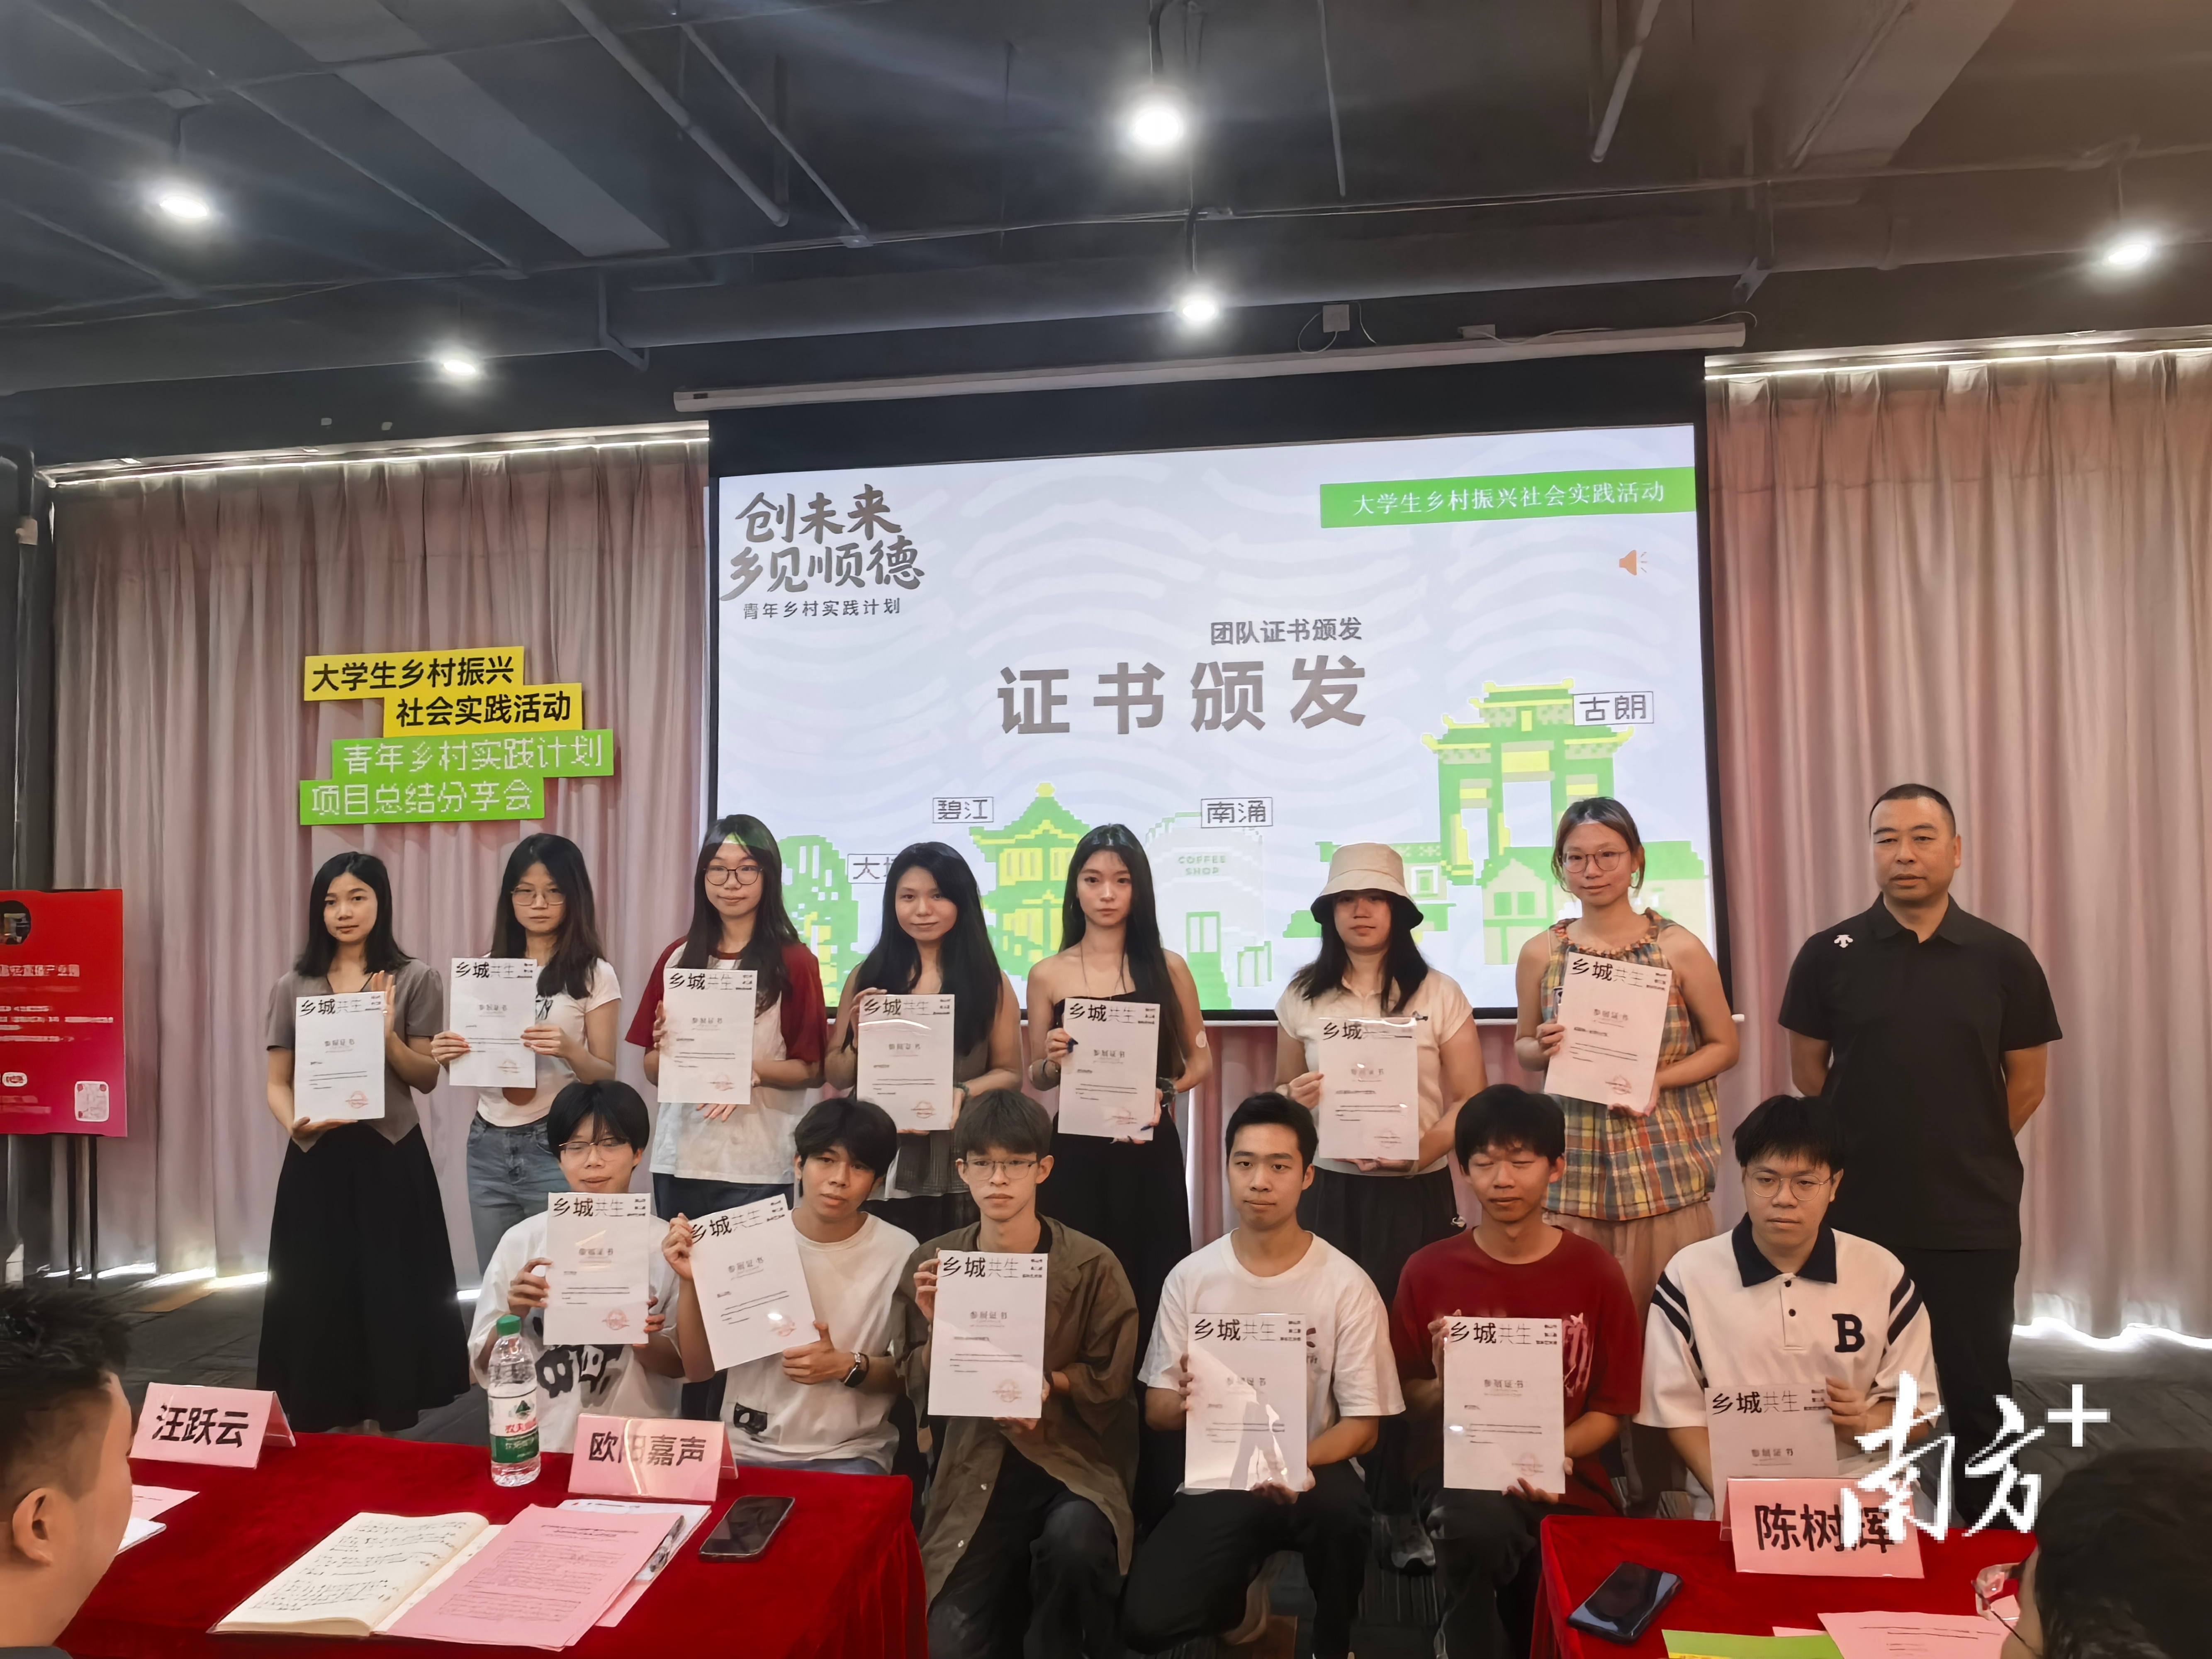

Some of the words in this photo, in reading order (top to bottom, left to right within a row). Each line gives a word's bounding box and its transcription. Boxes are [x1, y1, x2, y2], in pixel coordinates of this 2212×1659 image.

[1353, 481, 1664, 516] 大学生乡村振兴社会实践活动
[735, 484, 903, 544] 创未来
[720, 535, 925, 601] 乡见顺德
[743, 598, 900, 620] 青年乡村实践计划
[1210, 617, 1363, 645] 团队证书颁发
[311, 656, 514, 692] 大学生乡村振兴
[998, 655, 1366, 735] 证书颁发
[1578, 694, 1647, 722] 古朗
[396, 691, 571, 727] 社会实践活动
[343, 735, 602, 774] 青年乡村实践计划
[311, 778, 532, 816] 项目总结分享会
[937, 799, 989, 820] 碧江
[1207, 800, 1266, 824] 南涌
[1185, 867, 1219, 876] SHOP
[455, 961, 514, 978] 乡城共生
[669, 973, 733, 990] 乡城共生
[1569, 958, 1644, 987] 乡城共生
[299, 999, 364, 1017] 乡城共生
[864, 998, 930, 1016] 乡城共生
[1067, 1003, 1136, 1024] 乡城共生
[552, 1197, 623, 1217] 乡城共生
[691, 1209, 763, 1243] 乡城共生
[941, 1256, 1019, 1278] 乡城共生
[1195, 1318, 1275, 1341] 乡城共生
[1451, 1322, 1532, 1344] 乡城共生
[1832, 1314, 1865, 1352] B
[1712, 1391, 1800, 1415] 乡城共生
[152, 1403, 249, 1448] 汪跃云
